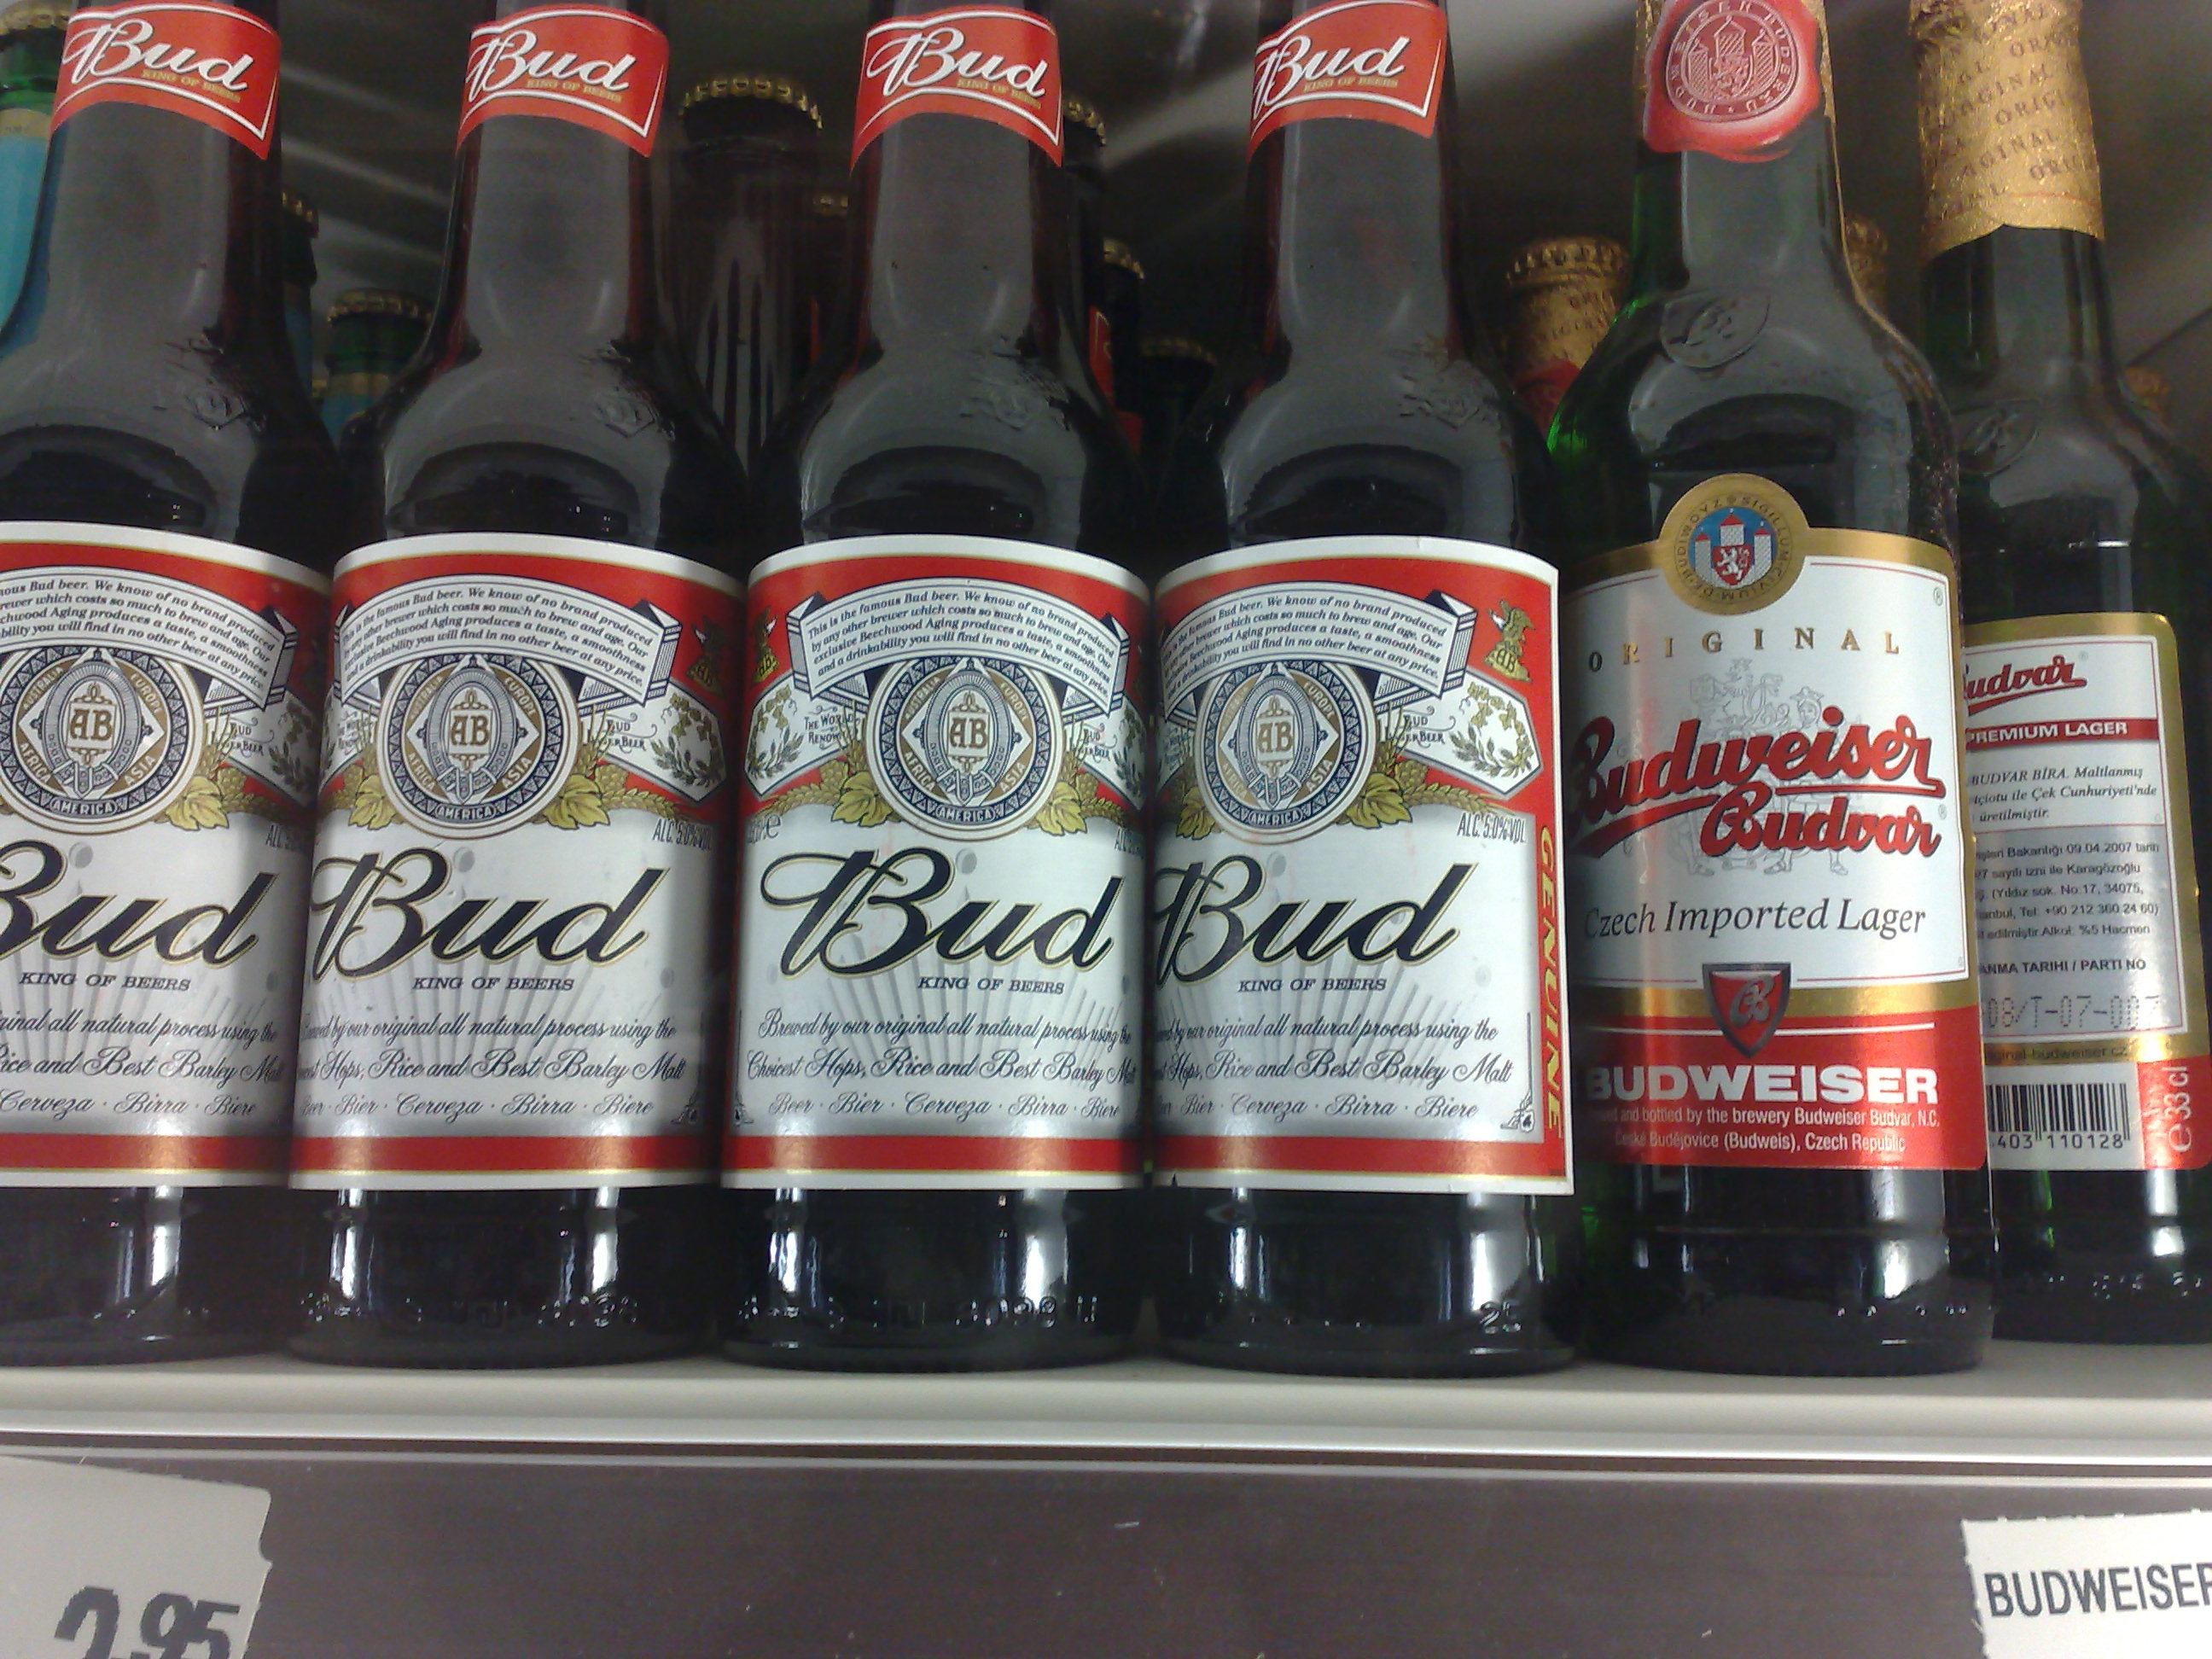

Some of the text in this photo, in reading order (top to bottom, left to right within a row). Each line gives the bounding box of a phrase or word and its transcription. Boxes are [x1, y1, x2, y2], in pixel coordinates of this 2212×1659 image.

[61, 18, 253, 91] Bud
[465, 29, 636, 103] Bud
[866, 26, 1048, 97] Bud
[180, 75, 201, 86] OF
[1253, 35, 1410, 120] Bud
[808, 591, 1115, 659] This is the famous Bud beer. We know of no brand produced
[812, 641, 823, 653] by
[823, 632, 841, 647] any
[841, 620, 868, 637] other
[870, 610, 909, 625] brewer
[911, 604, 946, 617] which
[948, 605, 976, 615] costs
[979, 608, 992, 617] so
[993, 609, 1024, 625] much
[1026, 616, 1036, 627] to
[1038, 620, 1062, 637] brew
[1062, 630, 1080, 647] and
[1097, 651, 1112, 669] Our
[813, 637, 858, 664] exclusive
[859, 619, 923, 642] Beechwood
[926, 617, 959, 632] Aging
[962, 617, 1015, 634] produces
[1027, 630, 1054, 649] taste,
[1063, 646, 1110, 684] smoothness
[818, 661, 835, 676] and
[846, 637, 907, 661] drinkability
[909, 634, 930, 648] you
[933, 631, 955, 642] will
[956, 631, 980, 643] find
[982, 632, 993, 644] in
[995, 637, 1010, 648] no
[1011, 640, 1039, 655] other
[1040, 649, 1062, 667] beer
[1062, 660, 1073, 671] at
[1073, 666, 1090, 684] any
[1088, 678, 1109, 698] price.
[1588, 627, 1901, 672] ORIGINAL
[70, 709, 114, 741] AB
[451, 714, 490, 748] AB
[949, 717, 987, 751] AB
[1258, 722, 1295, 754] AB
[1966, 721, 2129, 744] PREMIUM LAGER
[503, 757, 533, 791] ASIA
[999, 760, 1025, 794] ASIA
[1306, 759, 1335, 793] ASIA
[1569, 706, 1946, 845] Budweiser
[1971, 769, 2029, 787] BUDVAR
[2031, 786, 2056, 802] Çek
[436, 804, 492, 820] AMERICA
[938, 808, 992, 824] AMERICA
[1250, 811, 1300, 826] AMERICA
[1699, 780, 1942, 857] Budvar
[311, 847, 671, 985] Bud
[760, 846, 1124, 980] Bud
[1155, 854, 1479, 988] Bud
[1585, 898, 1927, 940] Czech Imported Lager
[19, 971, 192, 992] KING OF BEERS
[2080, 959, 2122, 971] PARTI
[2126, 958, 2147, 971] NO
[412, 976, 575, 992] KING OF BEERS
[917, 976, 1066, 995] KING OF BEERS
[1237, 978, 1388, 993] KING OF BEERS
[1540, 826, 1563, 1139] GENUINE
[758, 1008, 817, 1040] Brewed
[818, 1012, 841, 1045] by
[841, 1020, 870, 1037] our
[873, 1012, 947, 1044] original
[947, 1012, 976, 1037] all
[975, 1016, 1039, 1039] natural
[1033, 1024, 1090, 1050] process
[1090, 1023, 1119, 1052] using
[1352, 1017, 1499, 1050] process using the
[747, 1051, 803, 1081] Choicest
[804, 1049, 868, 1088] Hops,
[870, 1047, 934, 1079] Rice
[938, 1054, 978, 1078] and
[979, 1049, 1040, 1080] Best
[1042, 1052, 1104, 1091] Barley
[1205, 1048, 1514, 1091] Rice and Best Barley Malt
[1586, 1064, 1939, 1104] BUDWEISER
[114, 1091, 190, 1116] Birra
[396, 1091, 578, 1124] Cerveza Birra
[769, 1092, 815, 1115] Beer
[829, 1092, 884, 1115] Bier
[905, 1091, 992, 1124] Cerveza
[1008, 1095, 1069, 1117] Birra
[1231, 1092, 1308, 1124] Cerveza
[1324, 1094, 1397, 1117] Birra
[1642, 1107, 1684, 1123] bottled
[1686, 1107, 1703, 1126] by
[1707, 1107, 1728, 1124] the
[1733, 1107, 1790, 1127] brewery
[1794, 1107, 1866, 1126] Budweiser
[1870, 1108, 1915, 1127] Budvar,
[1918, 1109, 1940, 1127] N.C.
[1805, 1132, 1848, 1151] Czech
[1851, 1133, 1906, 1153] Republic
[1997, 1133, 2123, 1150] 403 110128
